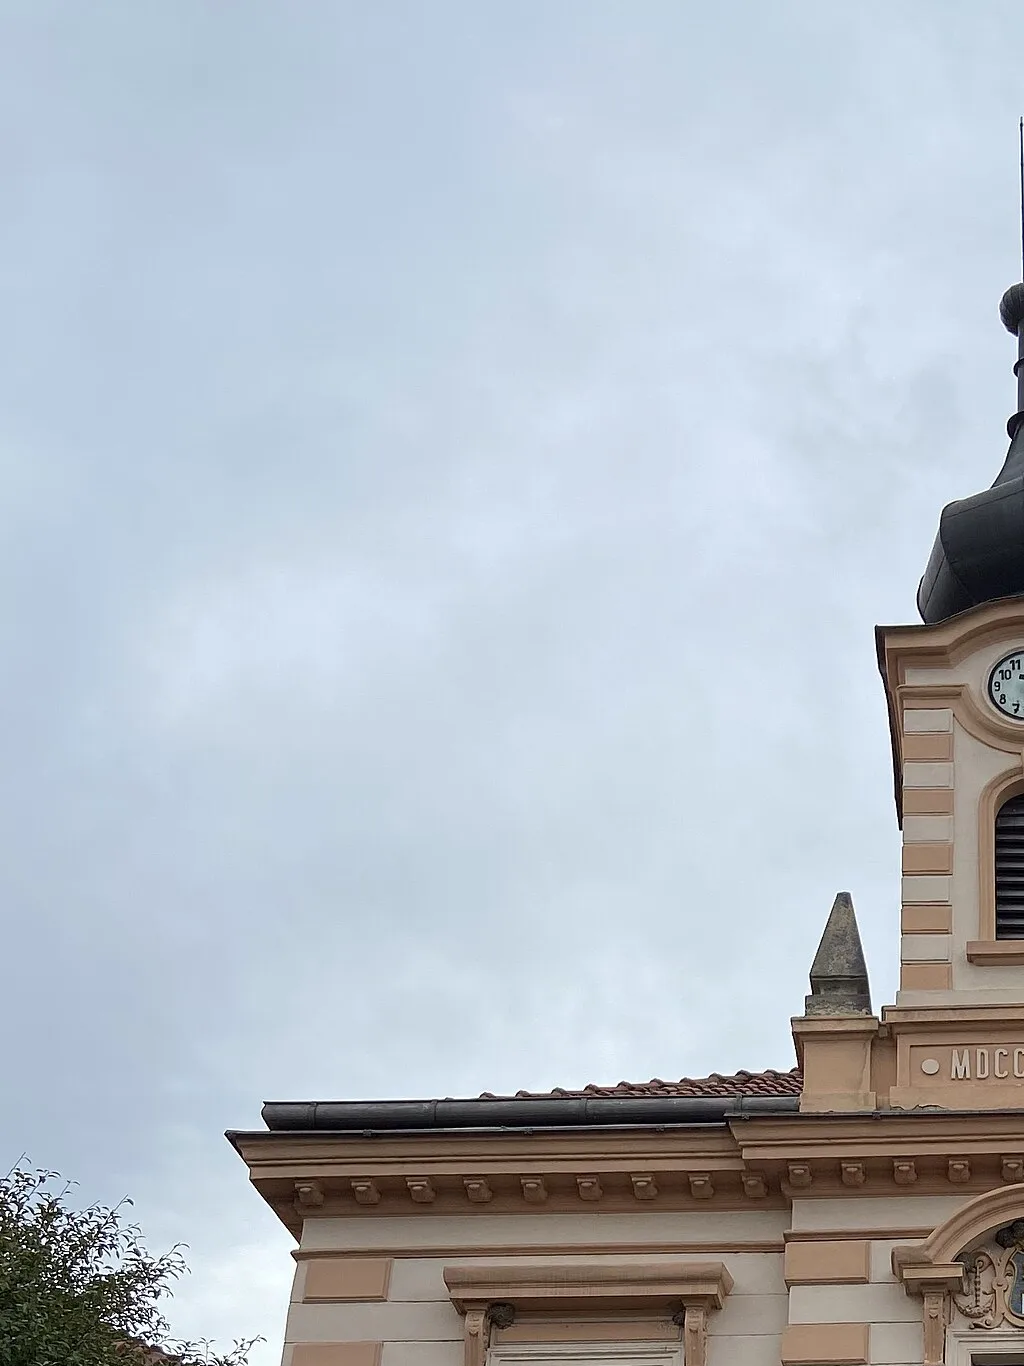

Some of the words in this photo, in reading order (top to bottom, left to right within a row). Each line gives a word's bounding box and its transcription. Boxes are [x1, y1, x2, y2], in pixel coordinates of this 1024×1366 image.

[1009, 660, 1021, 670] 11
[998, 669, 1012, 680] 10
[993, 681, 1001, 692] 9
[999, 693, 1007, 704] 8
[1012, 703, 1020, 714] 7
